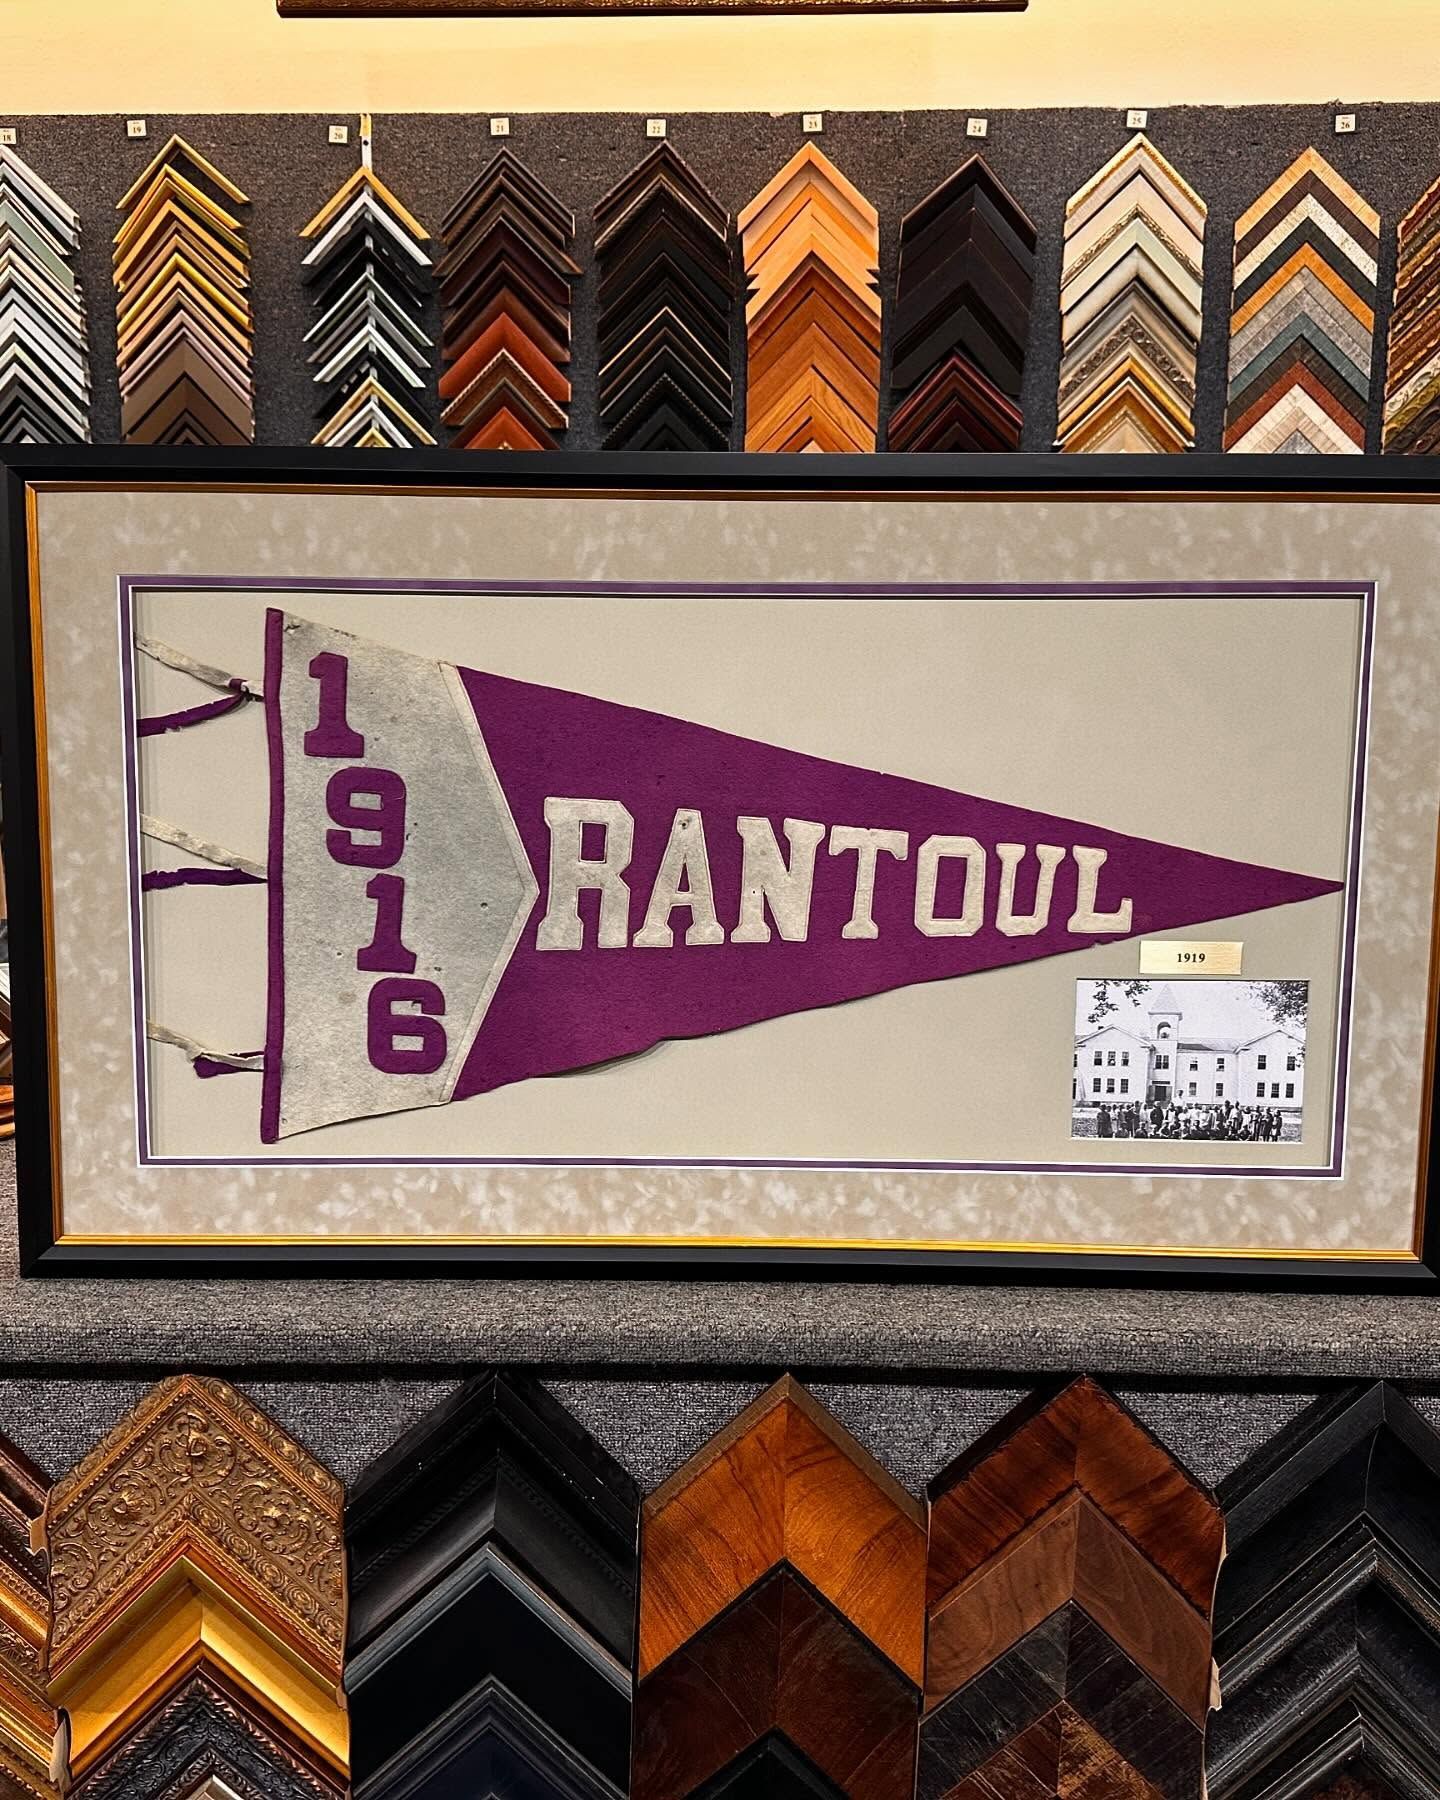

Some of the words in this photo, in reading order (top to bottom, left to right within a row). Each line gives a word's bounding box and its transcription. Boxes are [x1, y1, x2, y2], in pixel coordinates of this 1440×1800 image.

[132, 126, 142, 134] 19
[334, 132, 344, 140] 20
[304, 652, 448, 1075] 1916
[535, 796, 1134, 952] RANTOUL
[1177, 952, 1206, 963] 1919
